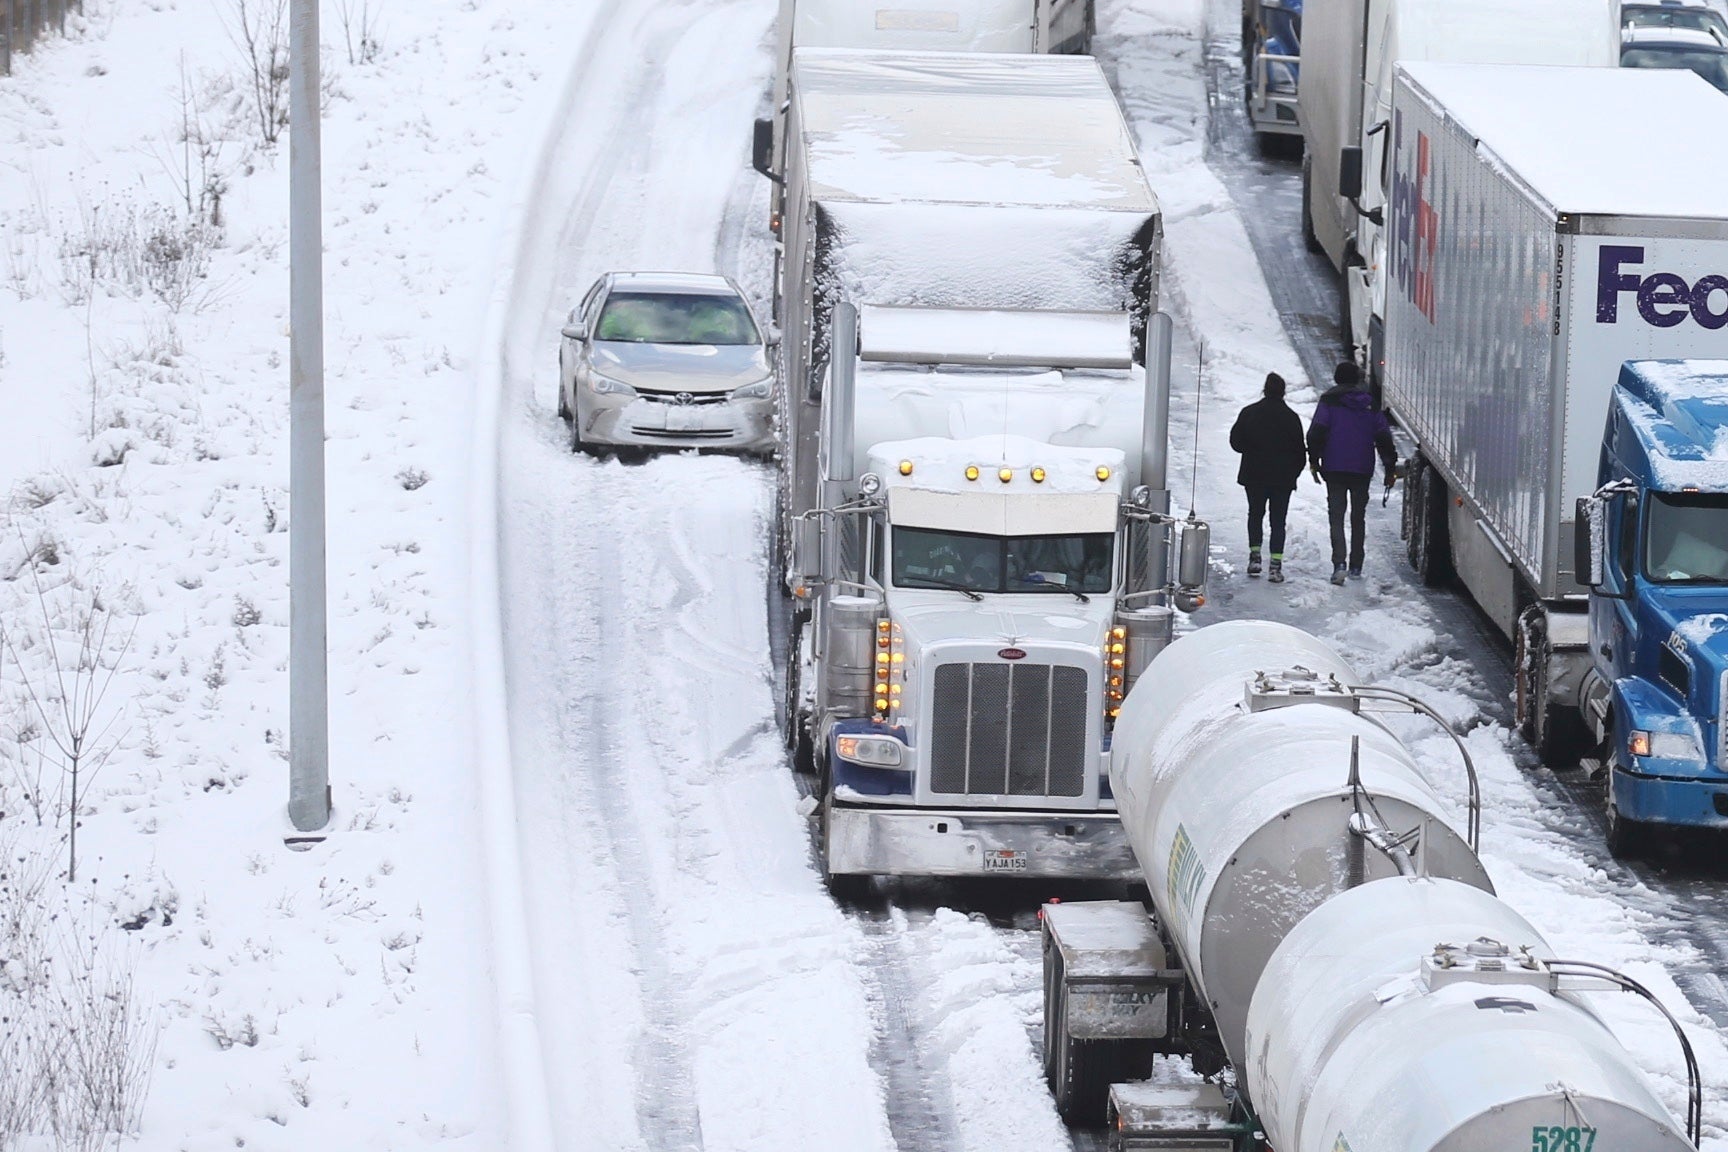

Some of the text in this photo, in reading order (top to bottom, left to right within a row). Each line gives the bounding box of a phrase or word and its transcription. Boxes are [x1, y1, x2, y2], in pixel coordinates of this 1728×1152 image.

[1554, 244, 1564, 336] 955148
[1667, 630, 1688, 653] 105
[1532, 1126, 1597, 1152] 5287
